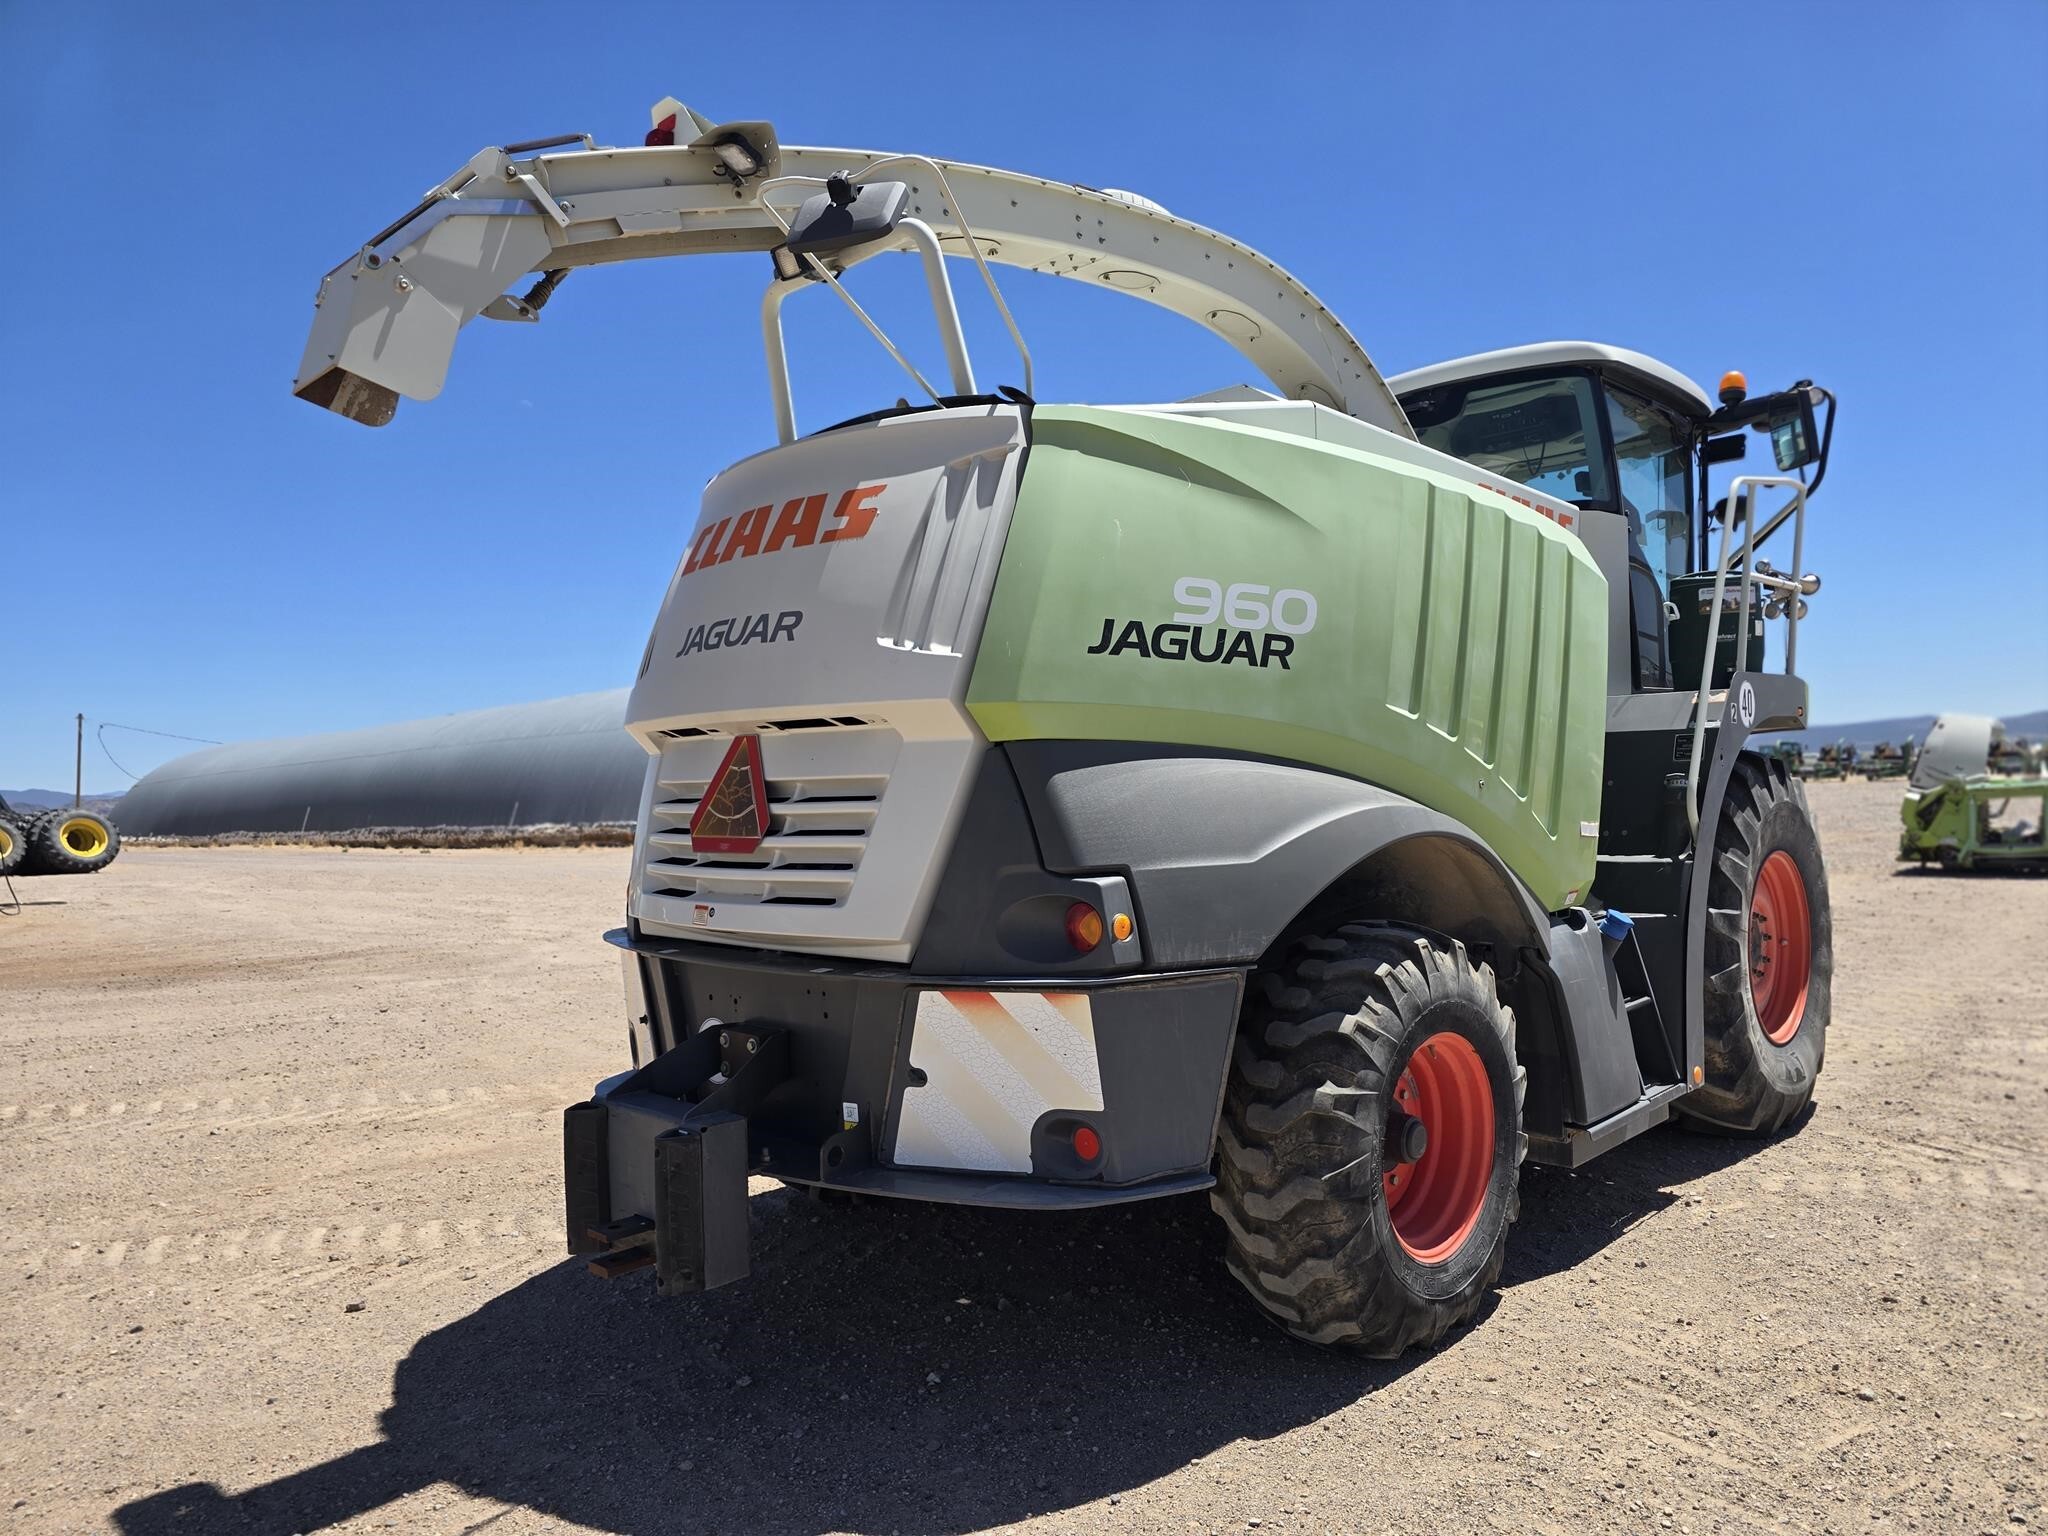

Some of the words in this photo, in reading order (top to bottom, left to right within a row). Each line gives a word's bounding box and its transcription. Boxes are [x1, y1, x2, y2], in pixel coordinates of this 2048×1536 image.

[681, 484, 887, 577] CLAAS
[1173, 576, 1318, 635] 960
[675, 610, 804, 658] JAGUAR
[1087, 618, 1295, 670] JAGUAR
[1742, 689, 1753, 718] 40
